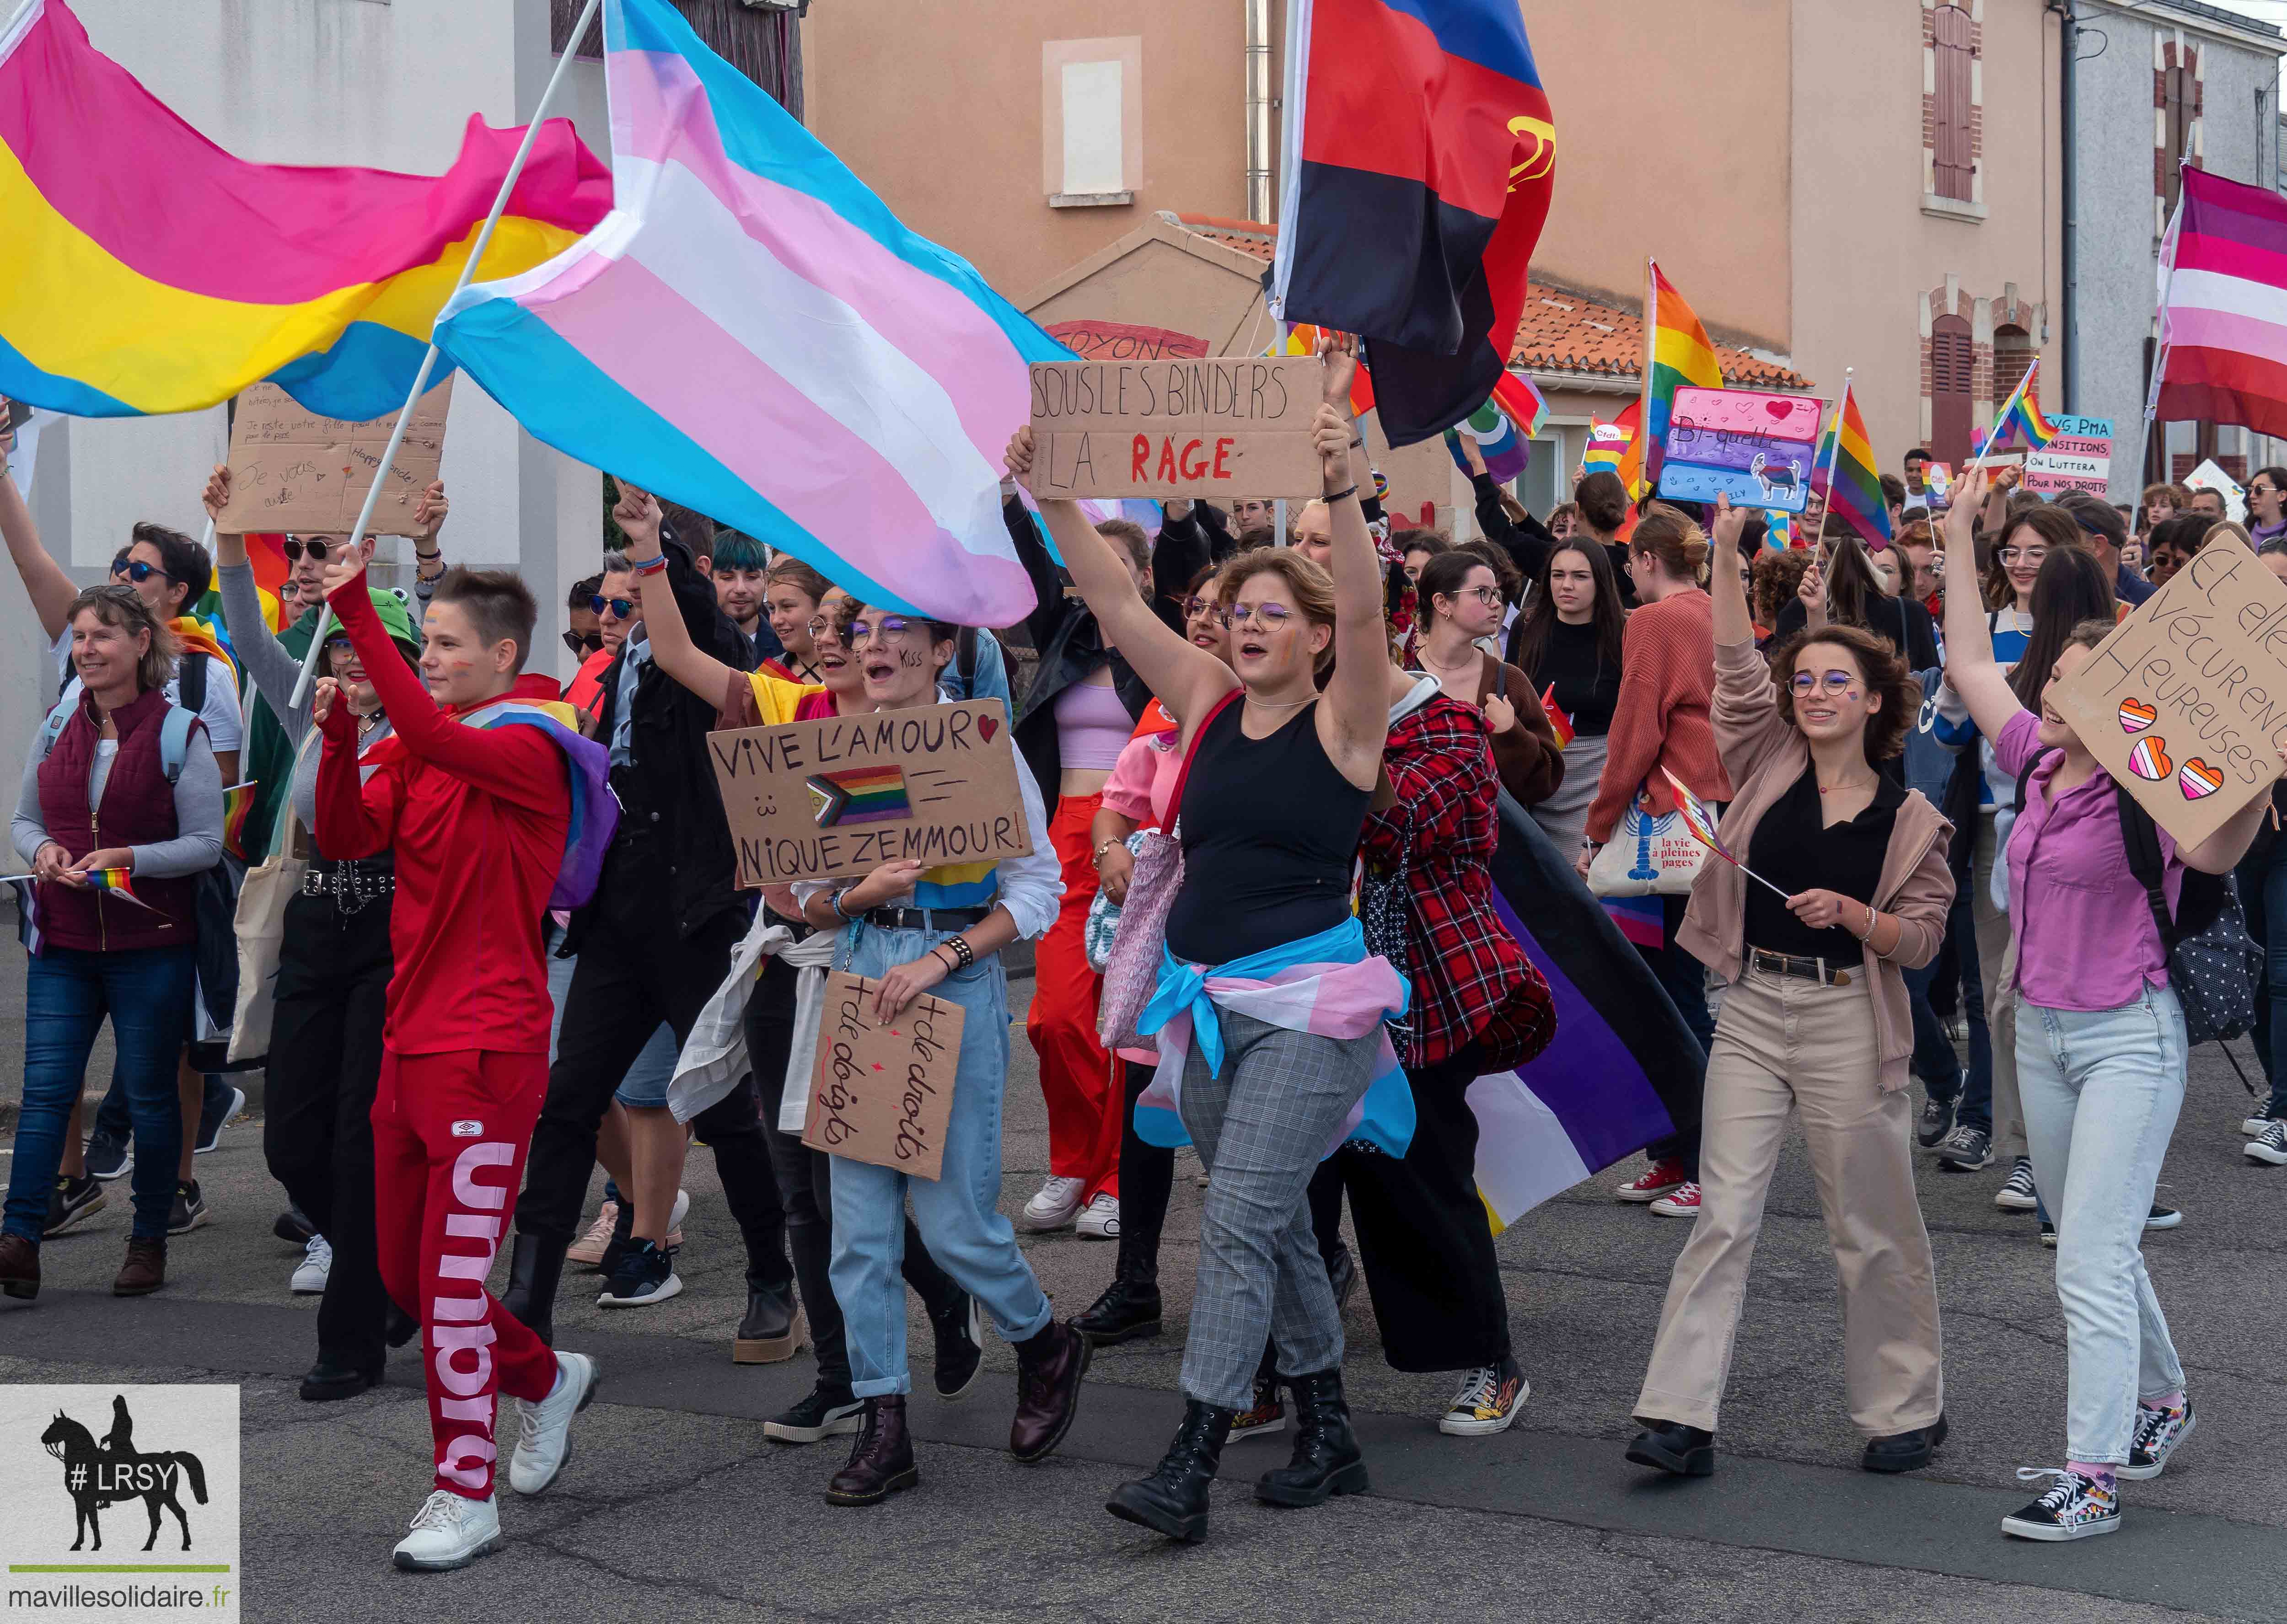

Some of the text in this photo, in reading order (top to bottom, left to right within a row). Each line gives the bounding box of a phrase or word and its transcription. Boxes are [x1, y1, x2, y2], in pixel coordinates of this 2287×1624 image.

[1168, 364, 1287, 419] BINDERS
[247, 421, 258, 429] Je
[262, 418, 284, 430] reste
[291, 418, 315, 429] votre
[352, 447, 382, 468] Happy
[1049, 431, 1095, 489] LA
[2047, 440, 2108, 456] ANSITIONS,
[236, 461, 316, 490] Je vous
[2054, 481, 2072, 490] NOS
[2075, 481, 2108, 493] DROITS
[2190, 549, 2242, 606] Et
[818, 709, 972, 763] L'AMOUR
[1652, 847, 1701, 859] à pleines
[1662, 838, 1691, 847] la vie
[1662, 859, 1694, 869] pages
[838, 1000, 871, 1040] de
[912, 1020, 945, 1062] de
[819, 1042, 866, 1145] doigts
[895, 1063, 937, 1159] droits
